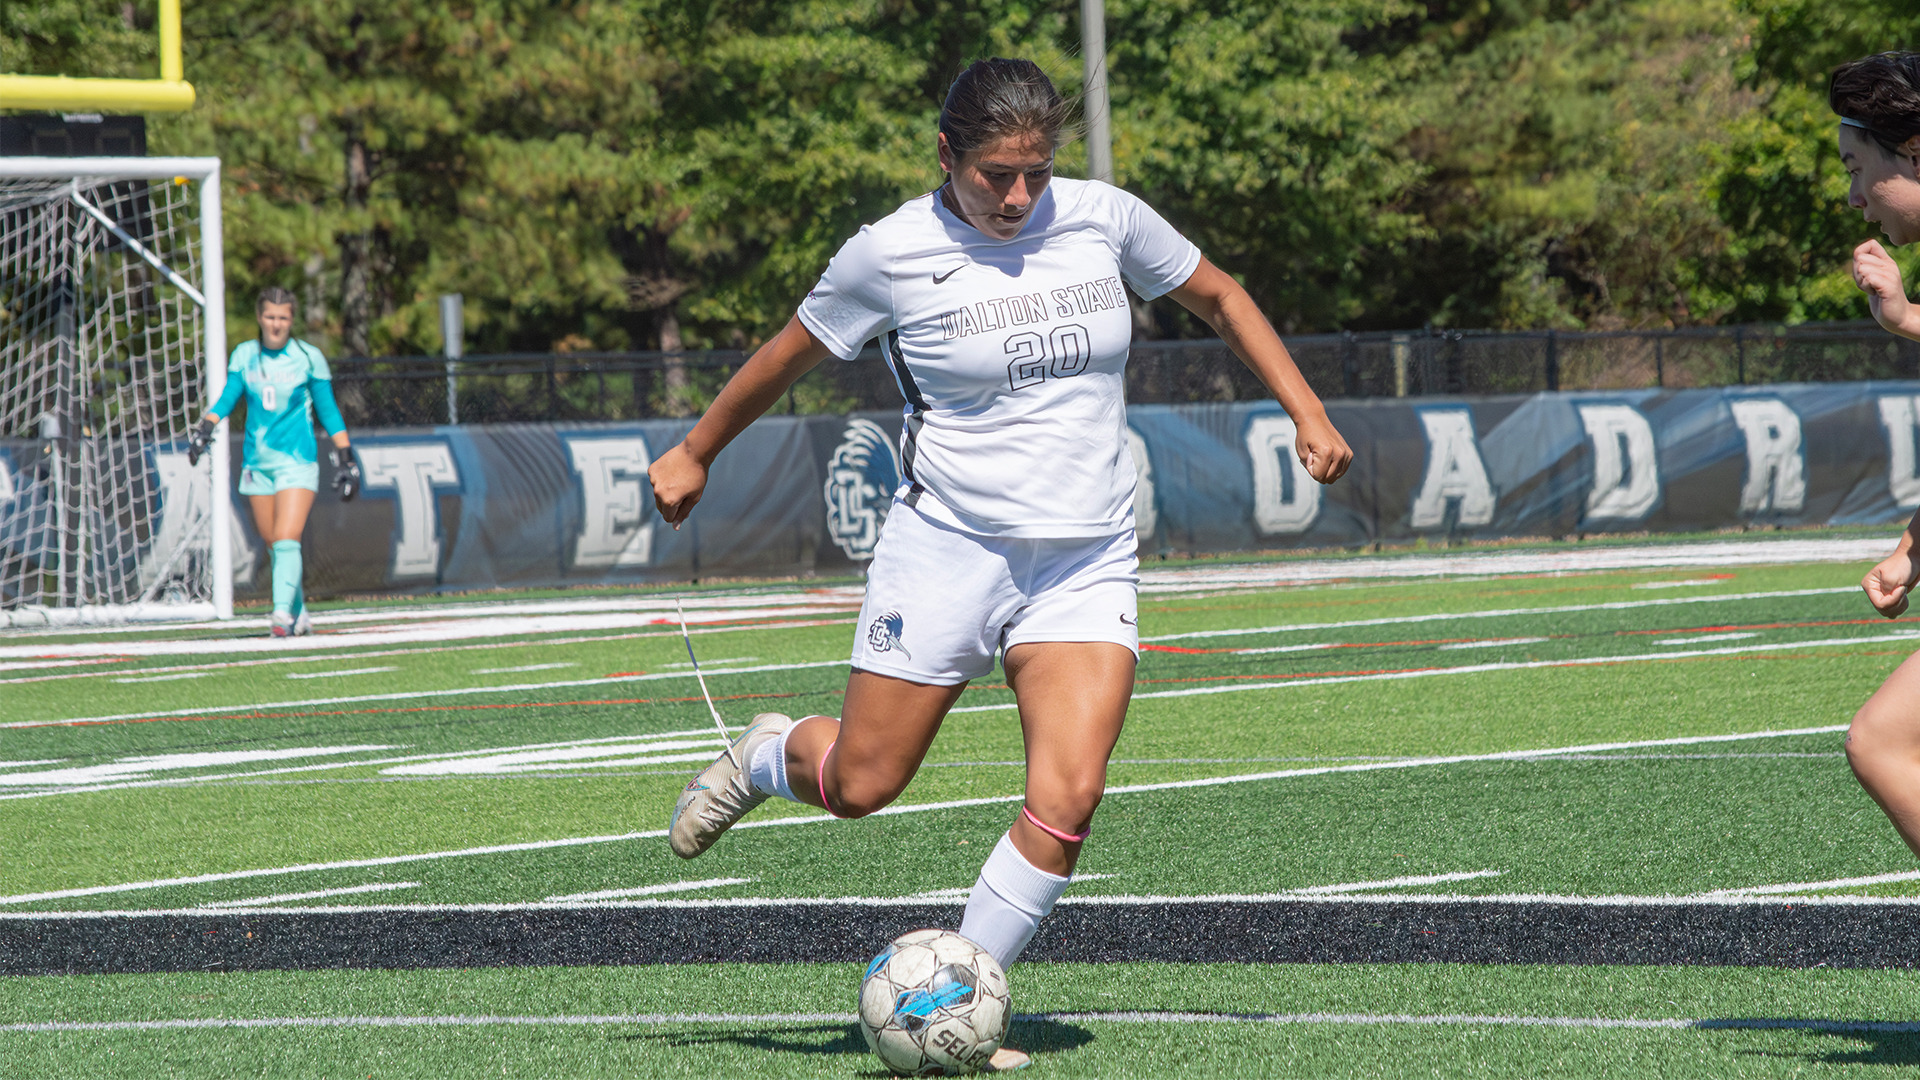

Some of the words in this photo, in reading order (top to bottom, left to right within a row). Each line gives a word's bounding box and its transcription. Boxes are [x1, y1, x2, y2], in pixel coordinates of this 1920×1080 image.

[940, 293, 1049, 341] DALTON
[1050, 276, 1126, 318] STATE
[1003, 323, 1091, 392] 20
[262, 385, 276, 411] 0
[0, 437, 654, 584] ATE
